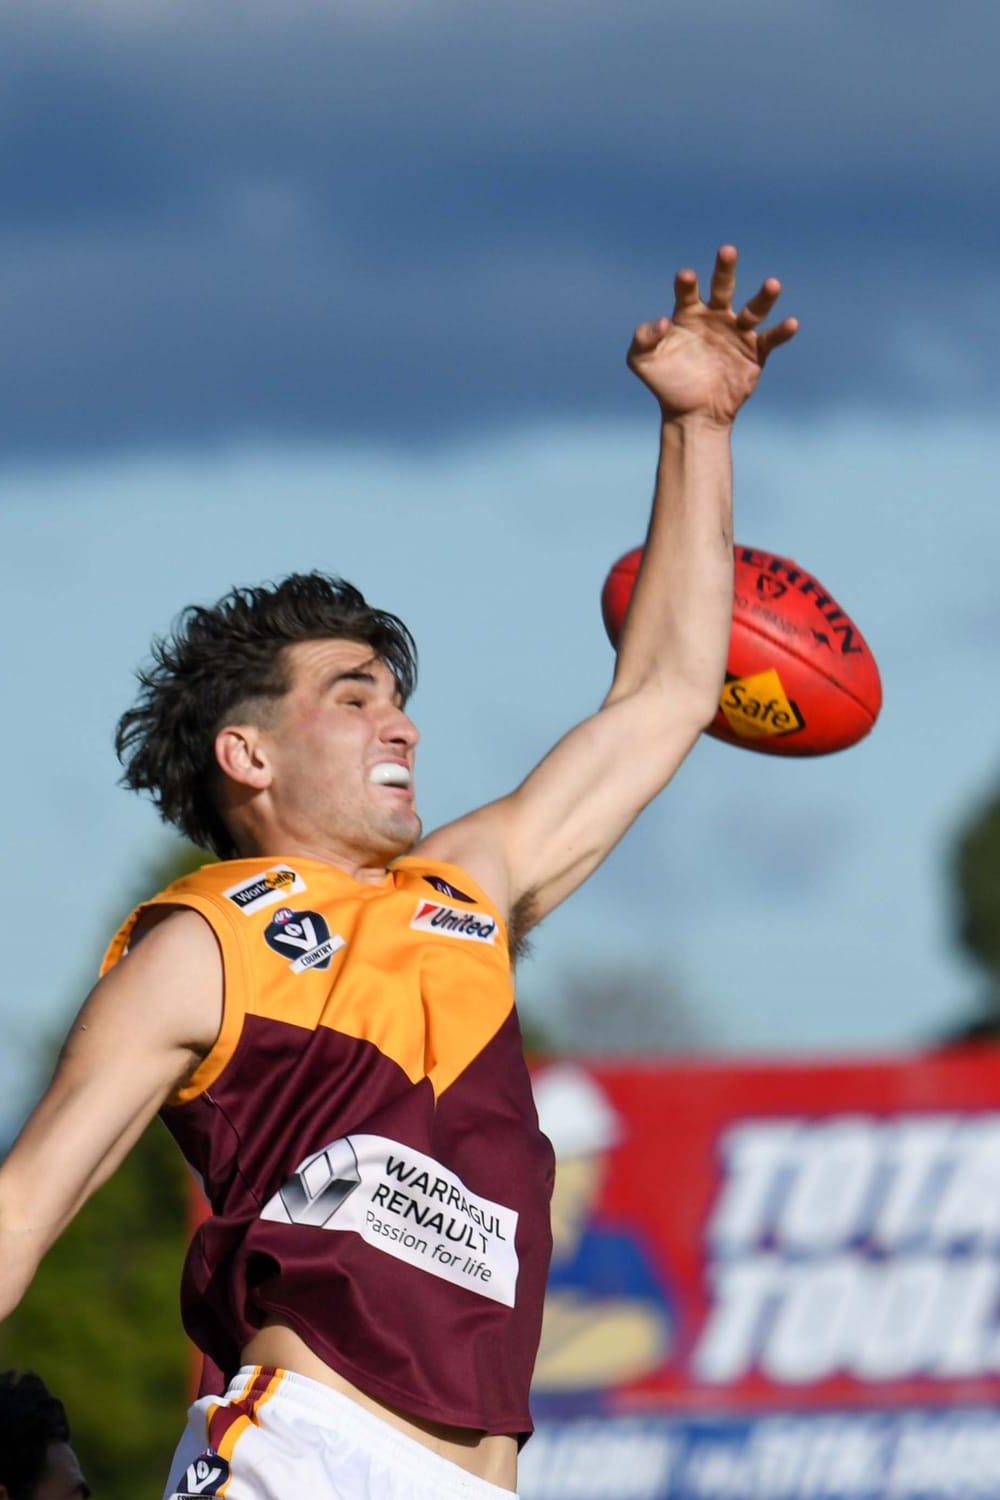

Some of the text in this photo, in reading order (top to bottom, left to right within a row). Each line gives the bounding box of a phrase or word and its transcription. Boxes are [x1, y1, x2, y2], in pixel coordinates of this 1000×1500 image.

[724, 685, 791, 731] Safe
[430, 907, 495, 939] United
[300, 942, 334, 967] COUNTRY
[370, 1183, 488, 1254] RENAULT
[385, 1155, 506, 1241] WARRAGUL
[366, 1210, 493, 1282] Passion for life
